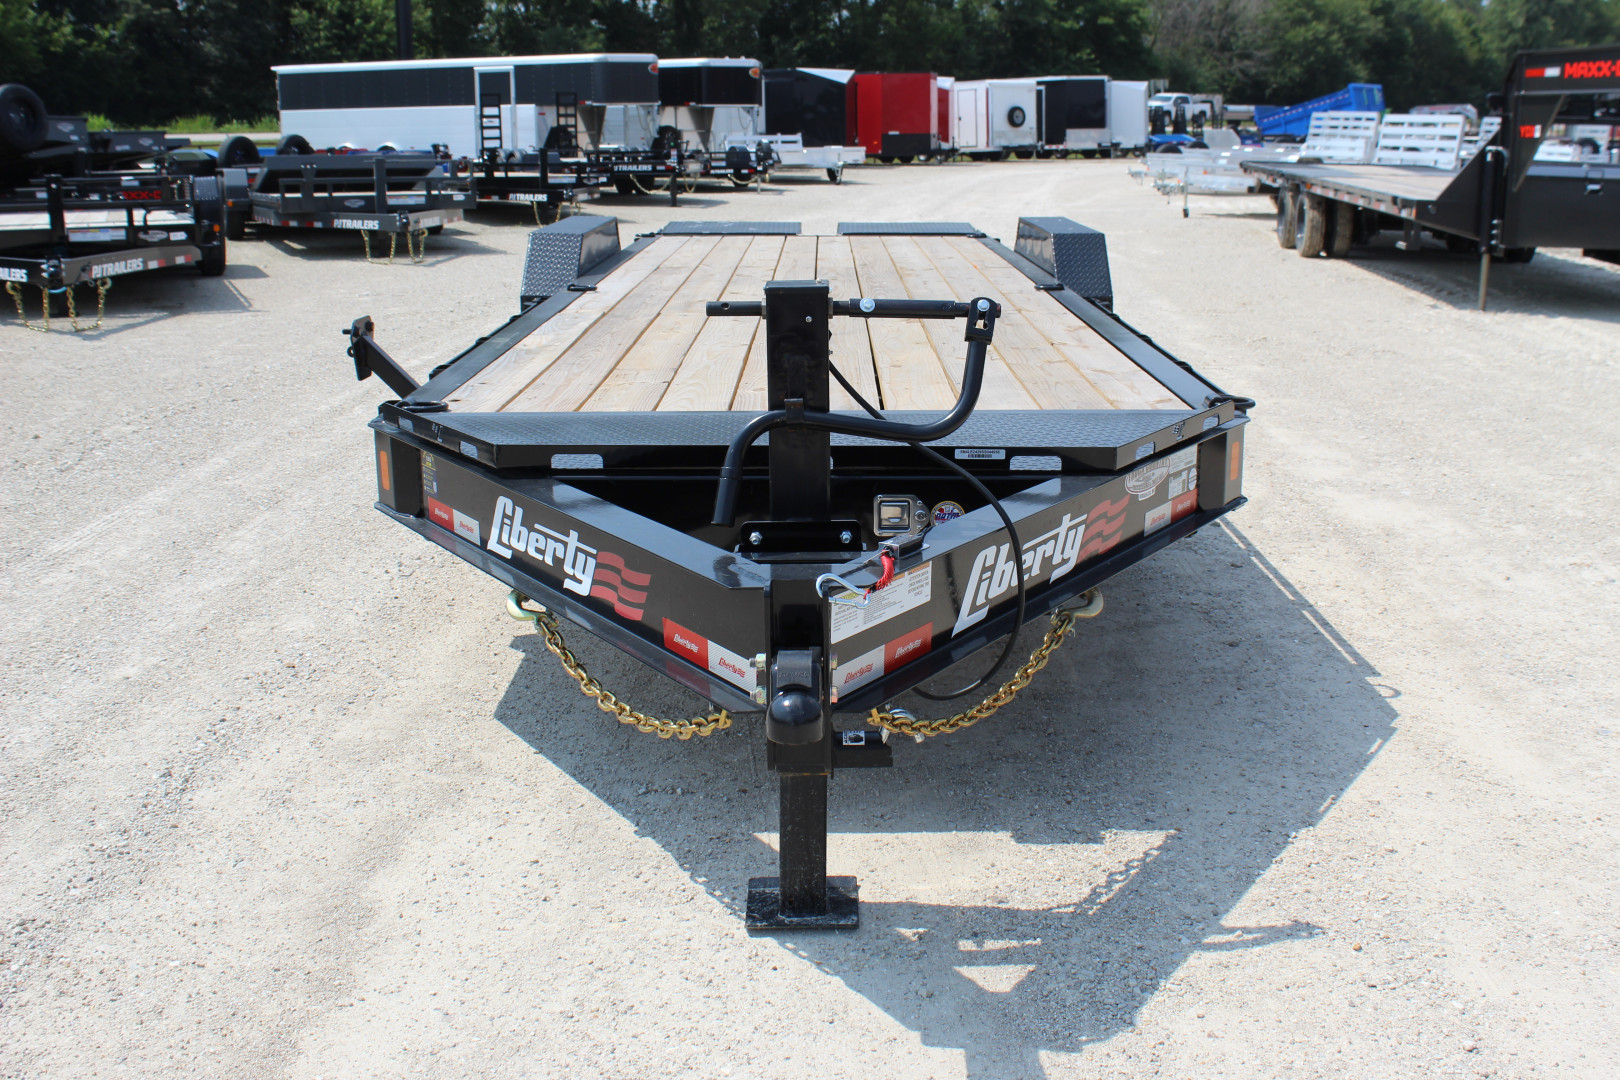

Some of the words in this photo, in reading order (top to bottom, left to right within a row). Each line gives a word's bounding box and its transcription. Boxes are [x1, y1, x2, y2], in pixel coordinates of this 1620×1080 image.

[487, 496, 597, 597] Liberty
[951, 513, 1088, 638] Liberty
[718, 657, 738, 674] Liberty
